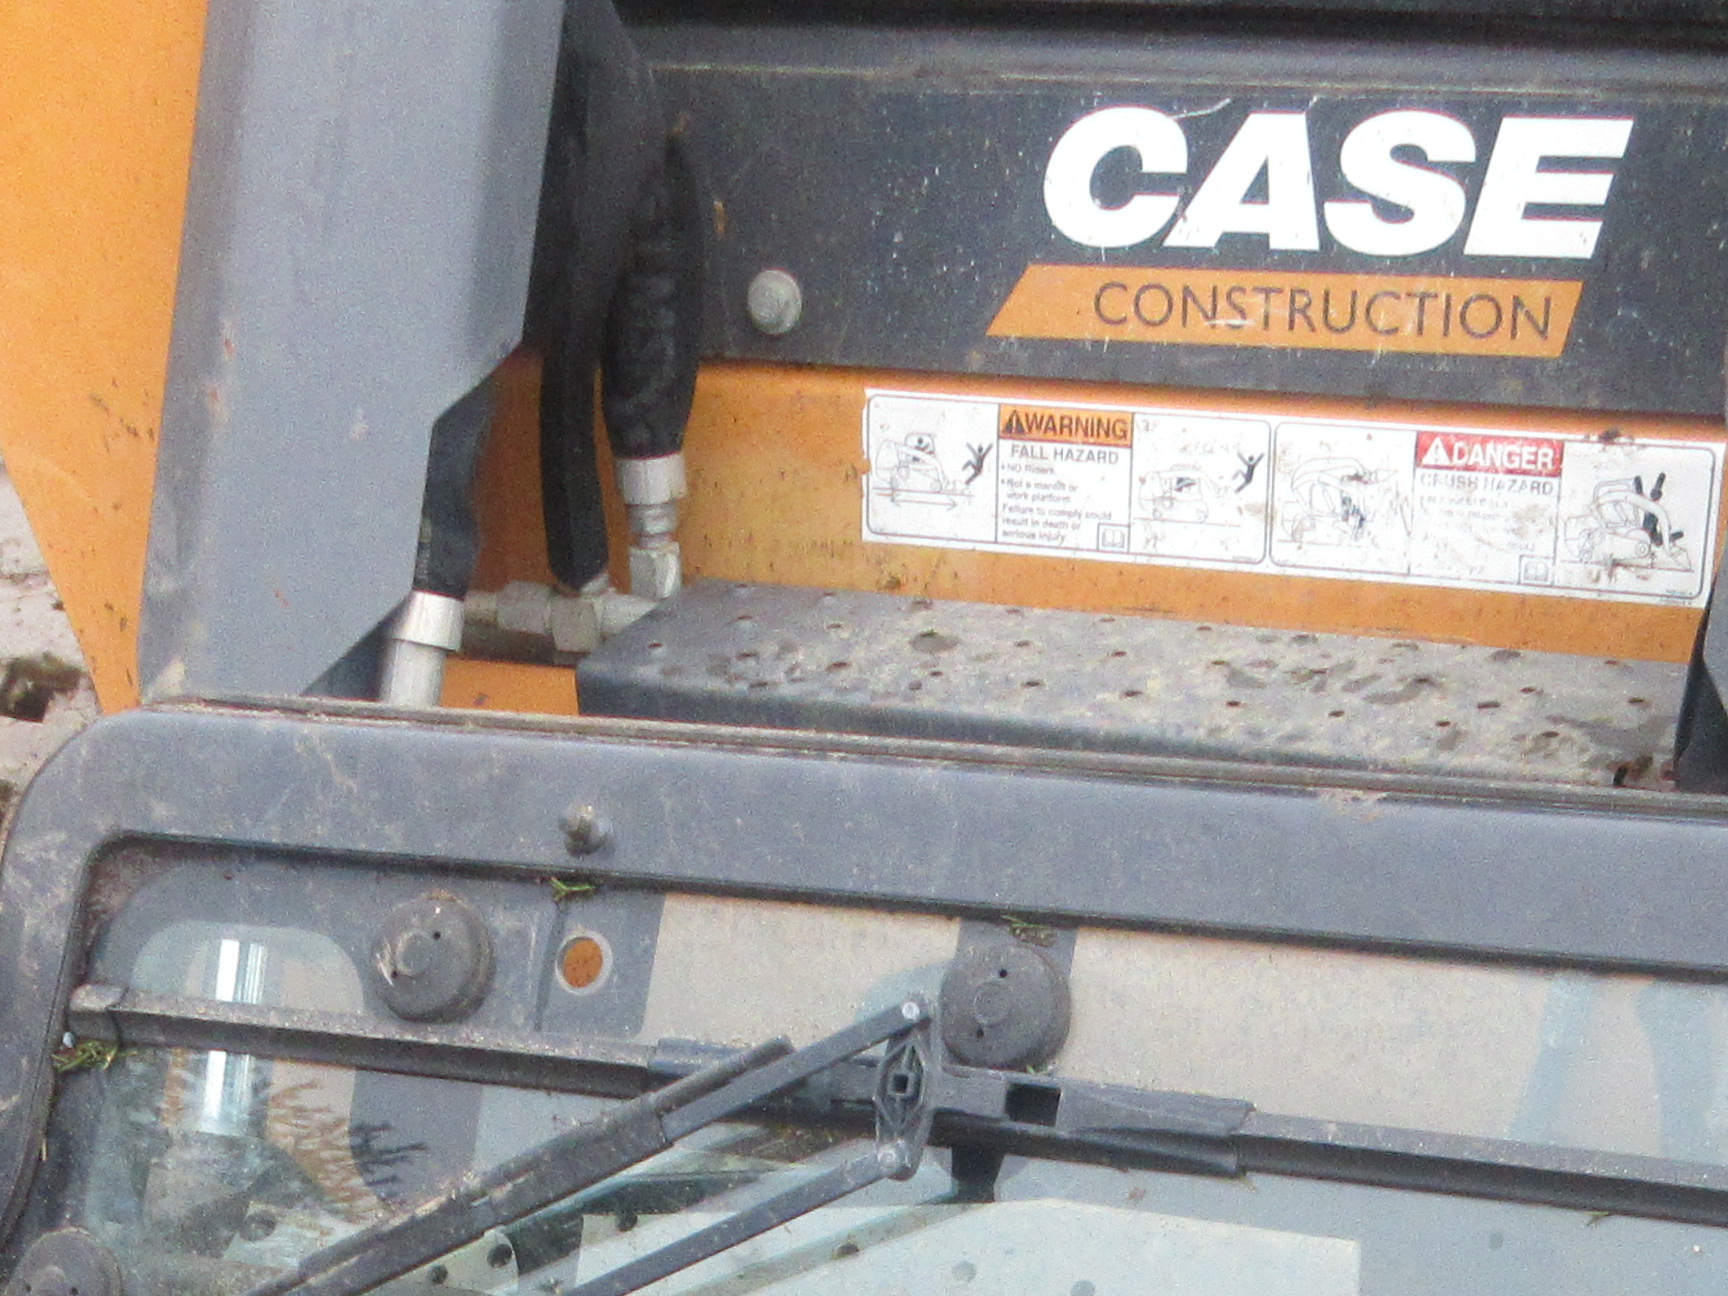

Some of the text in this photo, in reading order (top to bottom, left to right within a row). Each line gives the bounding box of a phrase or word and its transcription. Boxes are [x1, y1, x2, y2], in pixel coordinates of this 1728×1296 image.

[1043, 104, 1635, 260] CASE
[1093, 280, 1554, 342] CONSTRUCTION
[1025, 412, 1128, 441] WARNING
[1011, 444, 1120, 465] FALL HAZARD
[1452, 440, 1554, 470] DANGER
[1007, 491, 1029, 501] work
[1069, 484, 1079, 493] or
[1002, 503, 1034, 514] Failure
[1036, 506, 1045, 516] to
[1048, 508, 1083, 520] comply
[1002, 517, 1081, 531] result in death or
